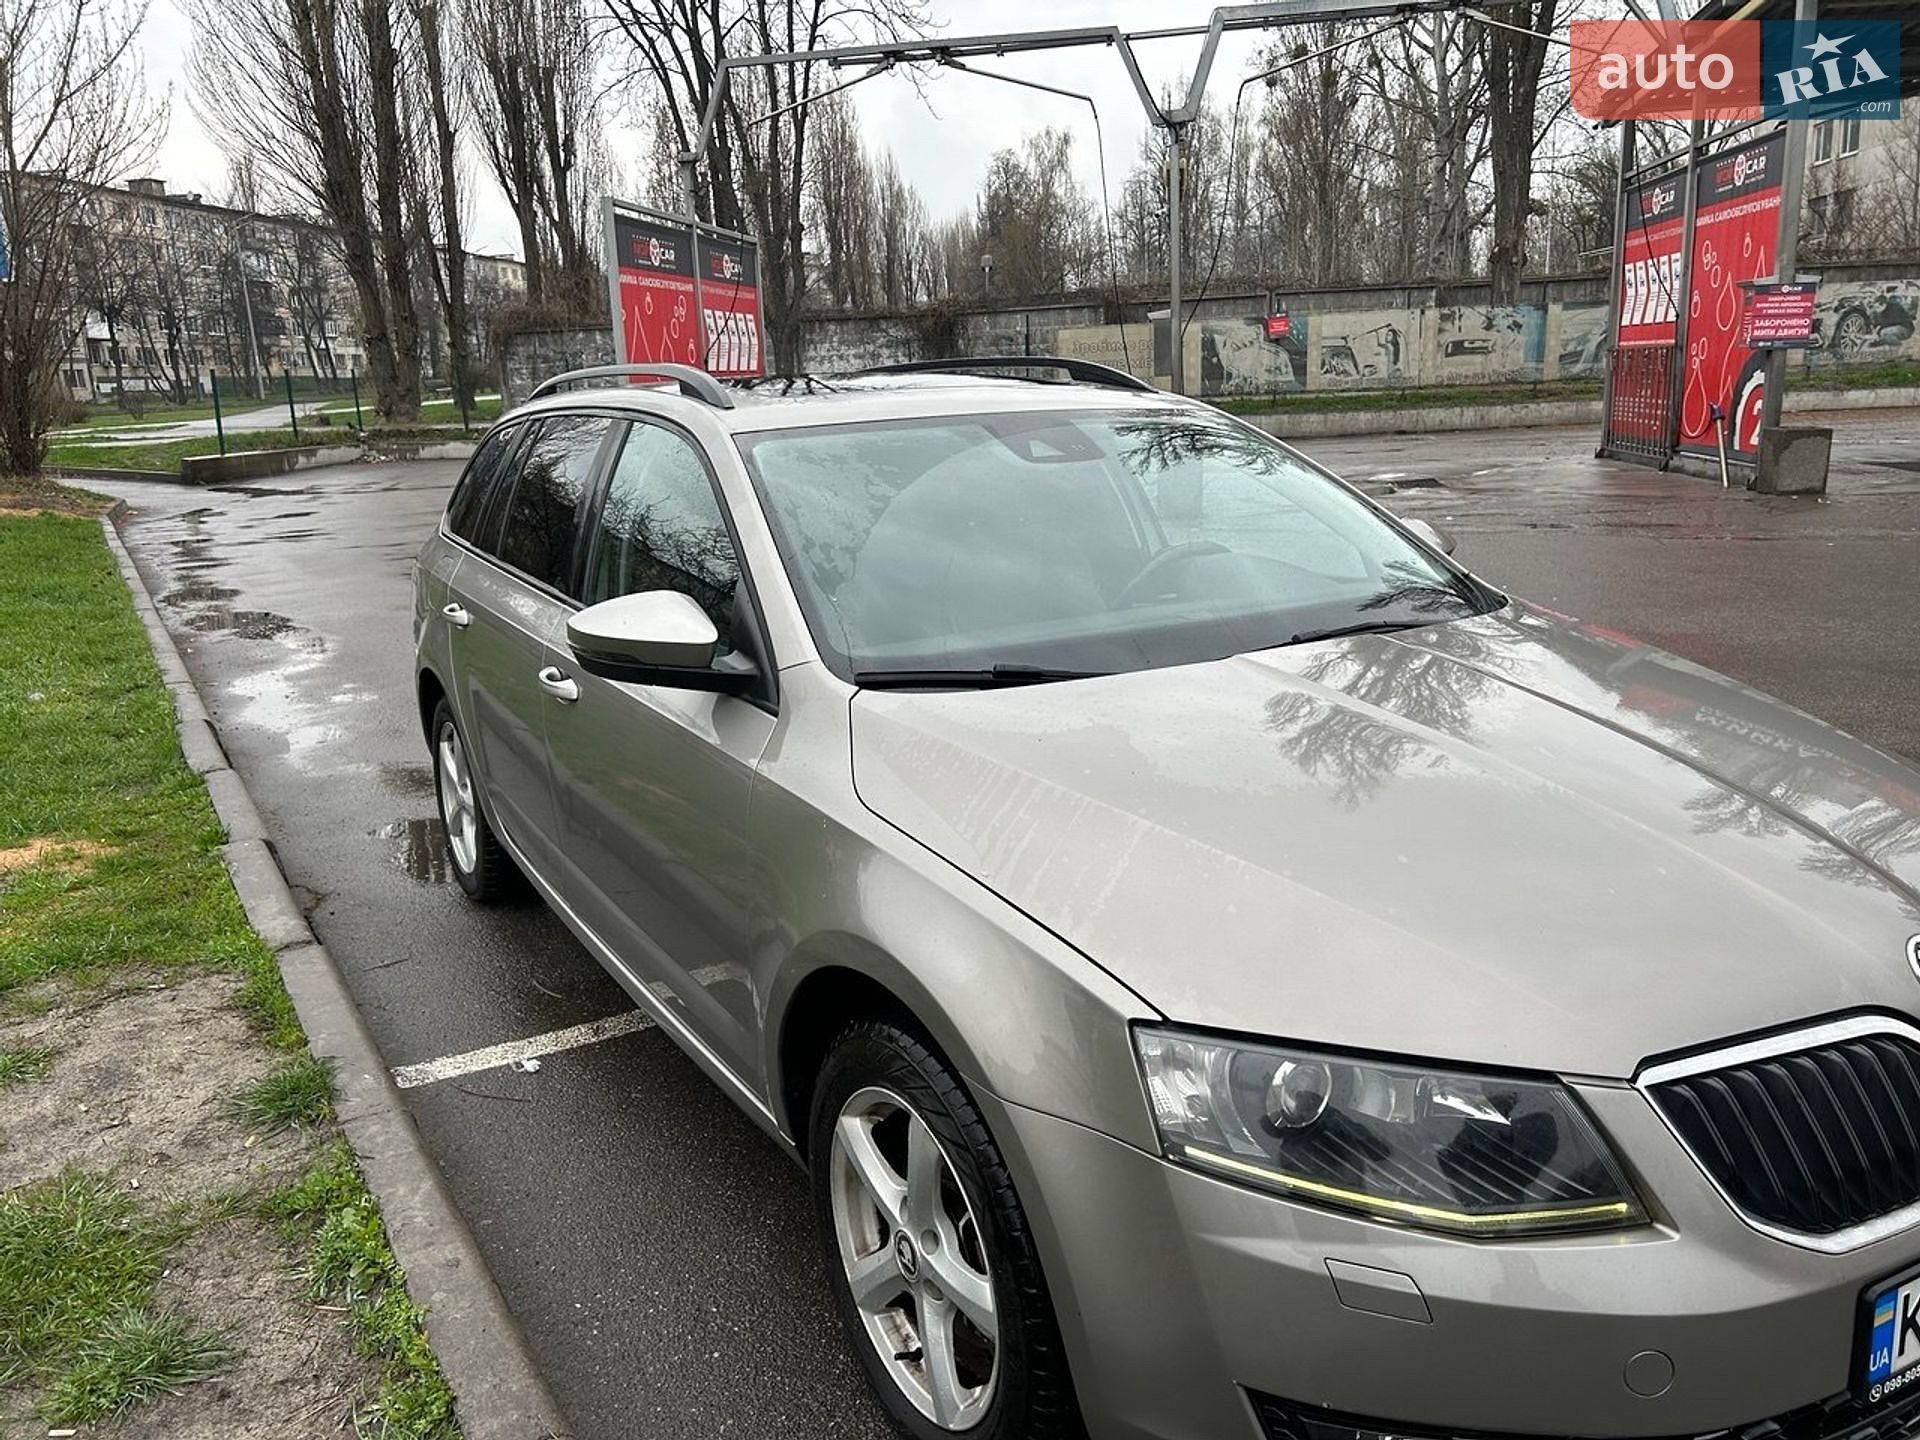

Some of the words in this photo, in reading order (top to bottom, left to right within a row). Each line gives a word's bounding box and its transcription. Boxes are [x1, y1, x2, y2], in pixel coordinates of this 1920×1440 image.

[1753, 318, 1810, 327] ЗАБОРОНЕНО
[1776, 328, 1809, 337] ДВИГУН
[1869, 1347, 1890, 1372] UA
